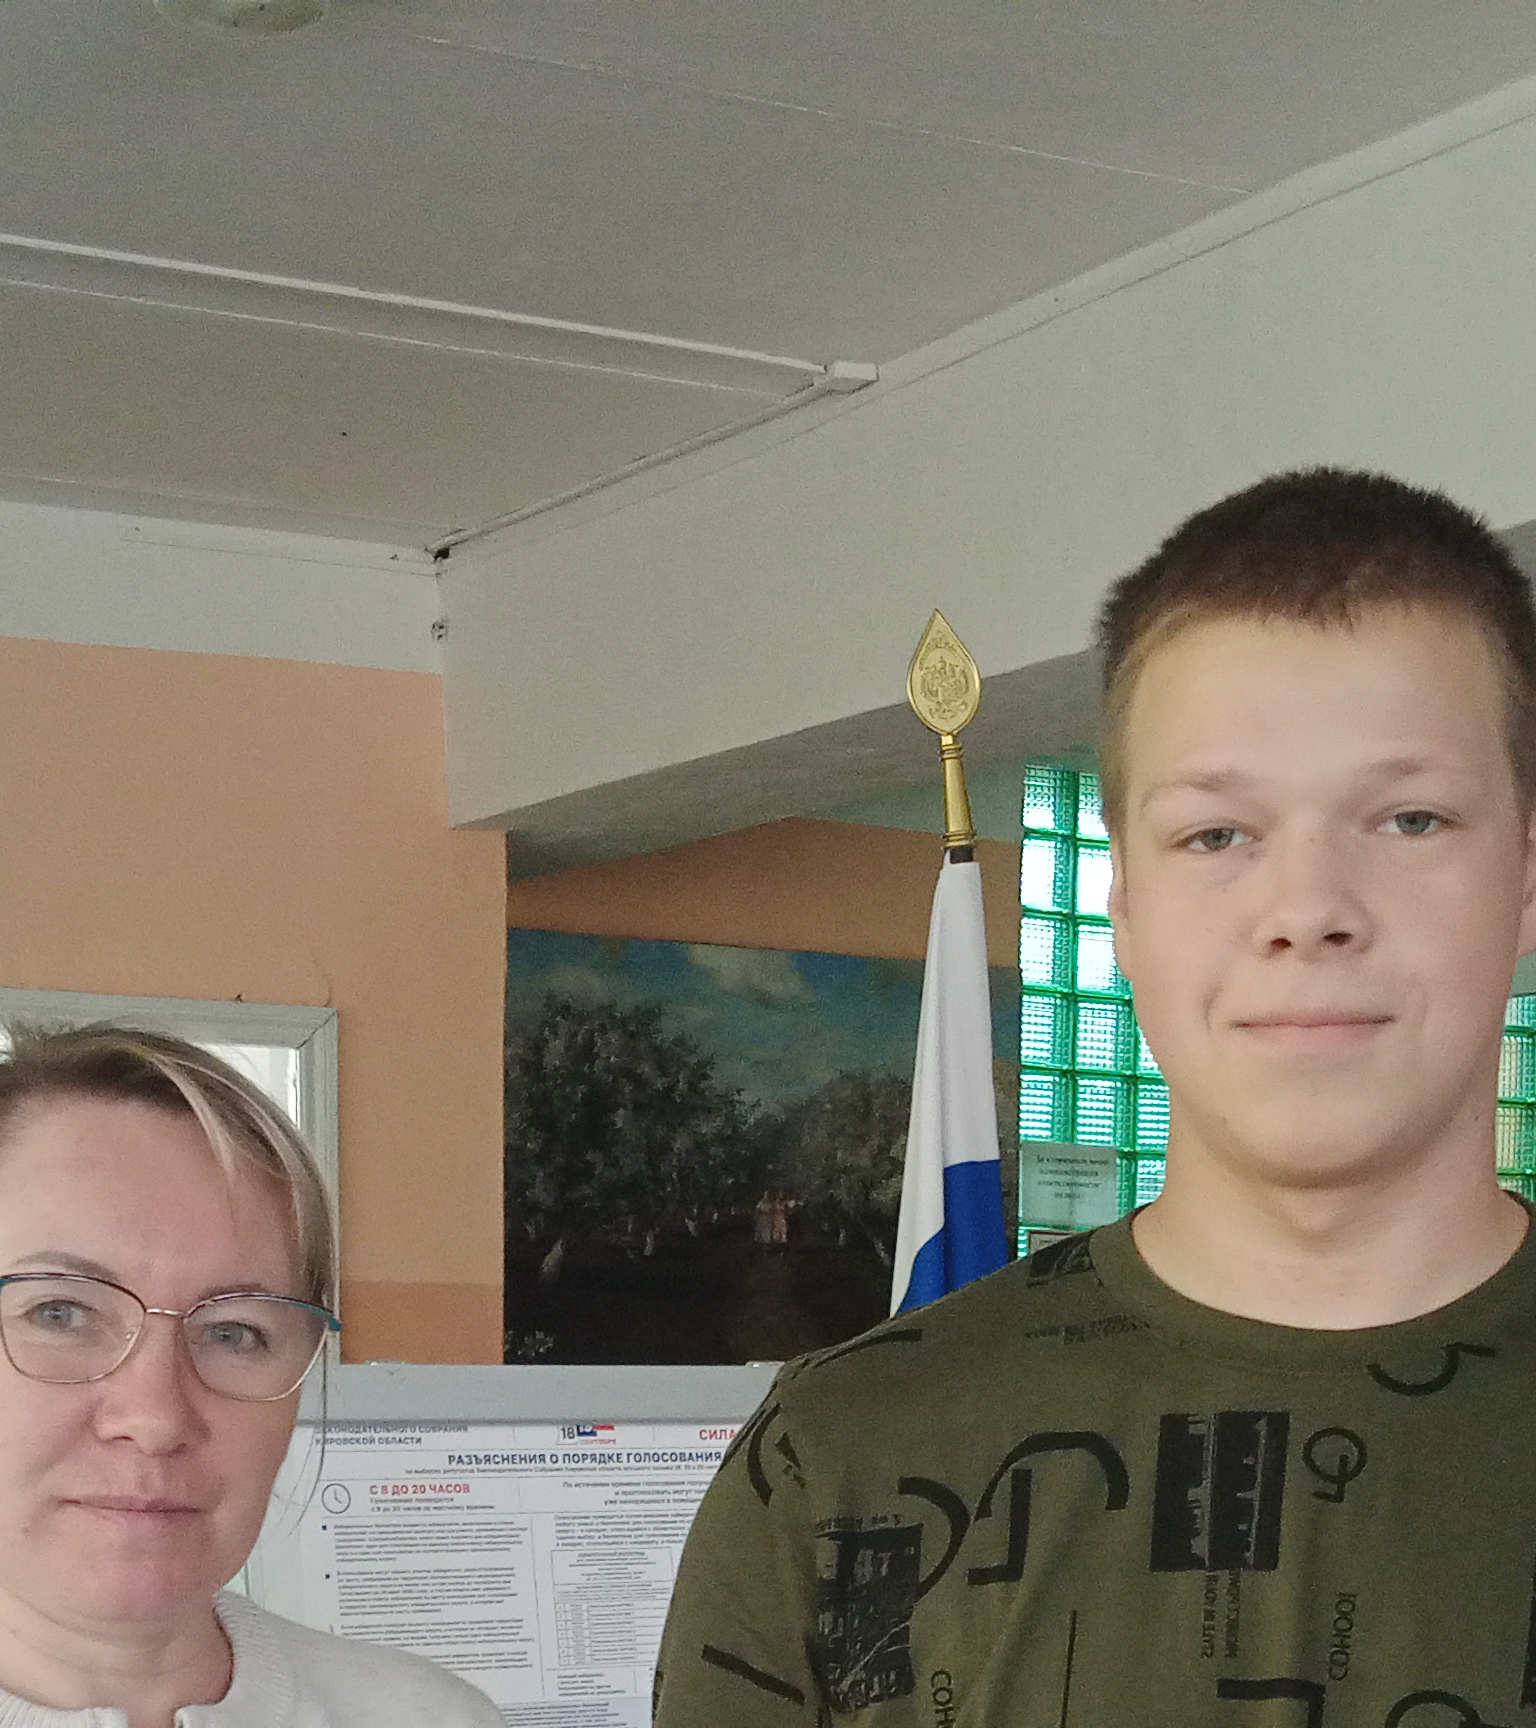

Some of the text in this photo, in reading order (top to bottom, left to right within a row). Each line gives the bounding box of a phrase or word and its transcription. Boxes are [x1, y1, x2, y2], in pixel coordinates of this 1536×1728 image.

[560, 1427, 576, 1440] 18
[377, 1435, 423, 1446] ОБЛАСТИ
[447, 1450, 723, 1467] РАЗЪЯСНЕНИЯ О ПОРЯДКЕ ГОЛОСОВАНИЯ
[370, 1485, 379, 1495] С
[391, 1484, 409, 1496] ДО
[411, 1484, 427, 1494] 20
[429, 1483, 471, 1494] ЧАСОВ
